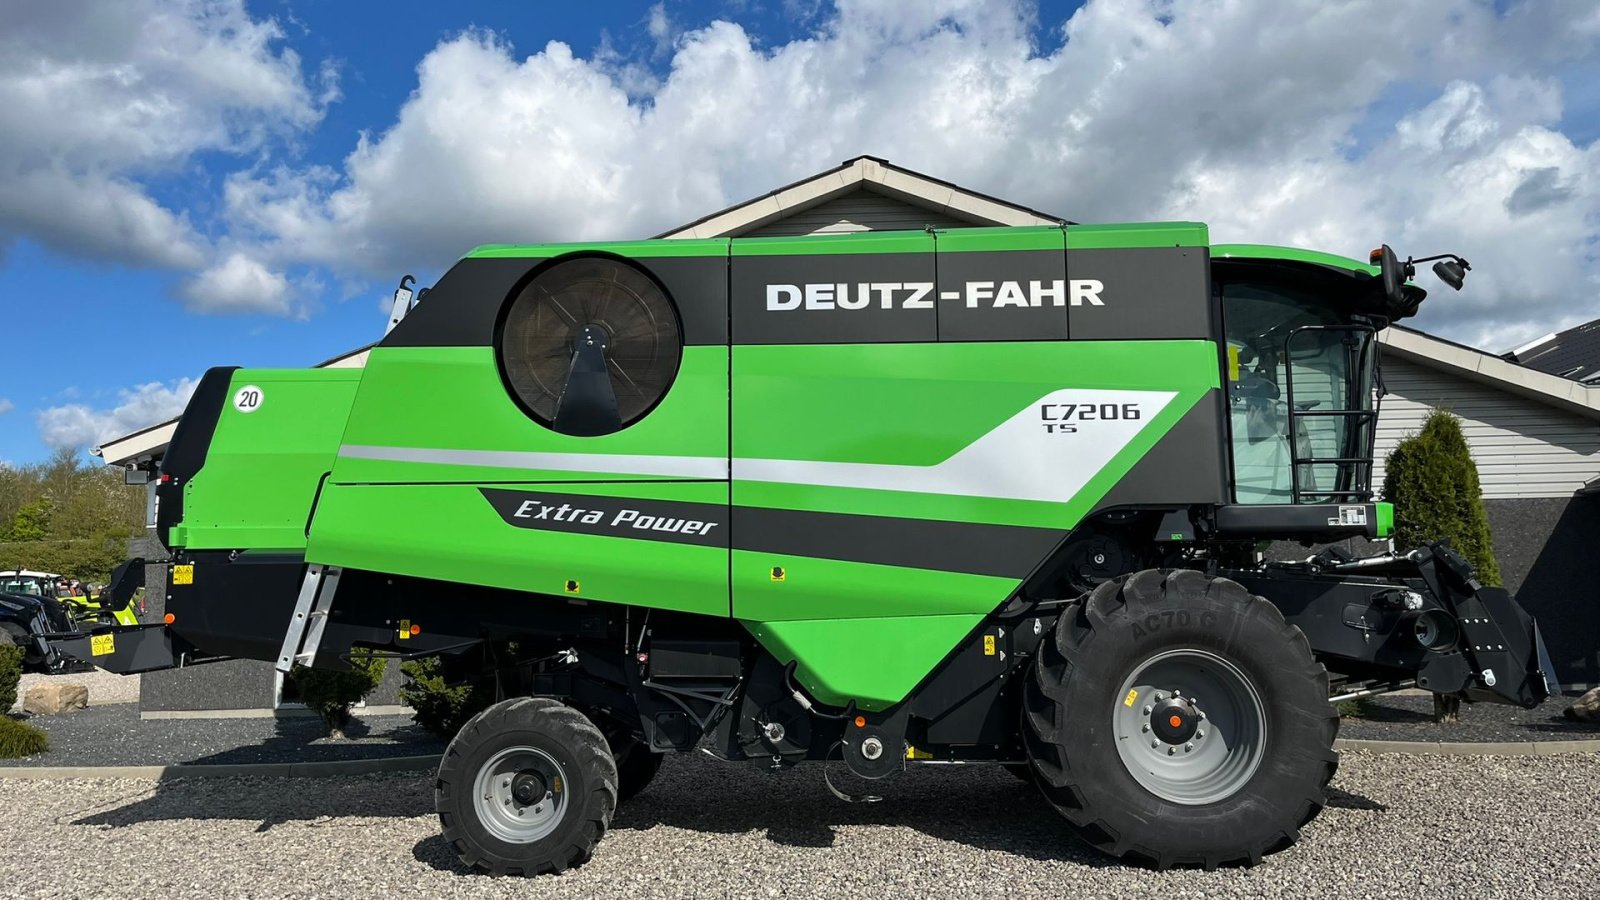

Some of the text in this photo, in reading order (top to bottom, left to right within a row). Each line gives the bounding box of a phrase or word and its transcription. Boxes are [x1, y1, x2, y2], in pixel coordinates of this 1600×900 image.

[766, 279, 1105, 311] DEUTZ-FAHR
[239, 391, 258, 407] 20
[1041, 404, 1140, 420] C7206
[1042, 424, 1077, 433] TS
[514, 500, 718, 536] Extra Power
[1131, 610, 1191, 640] AC70
